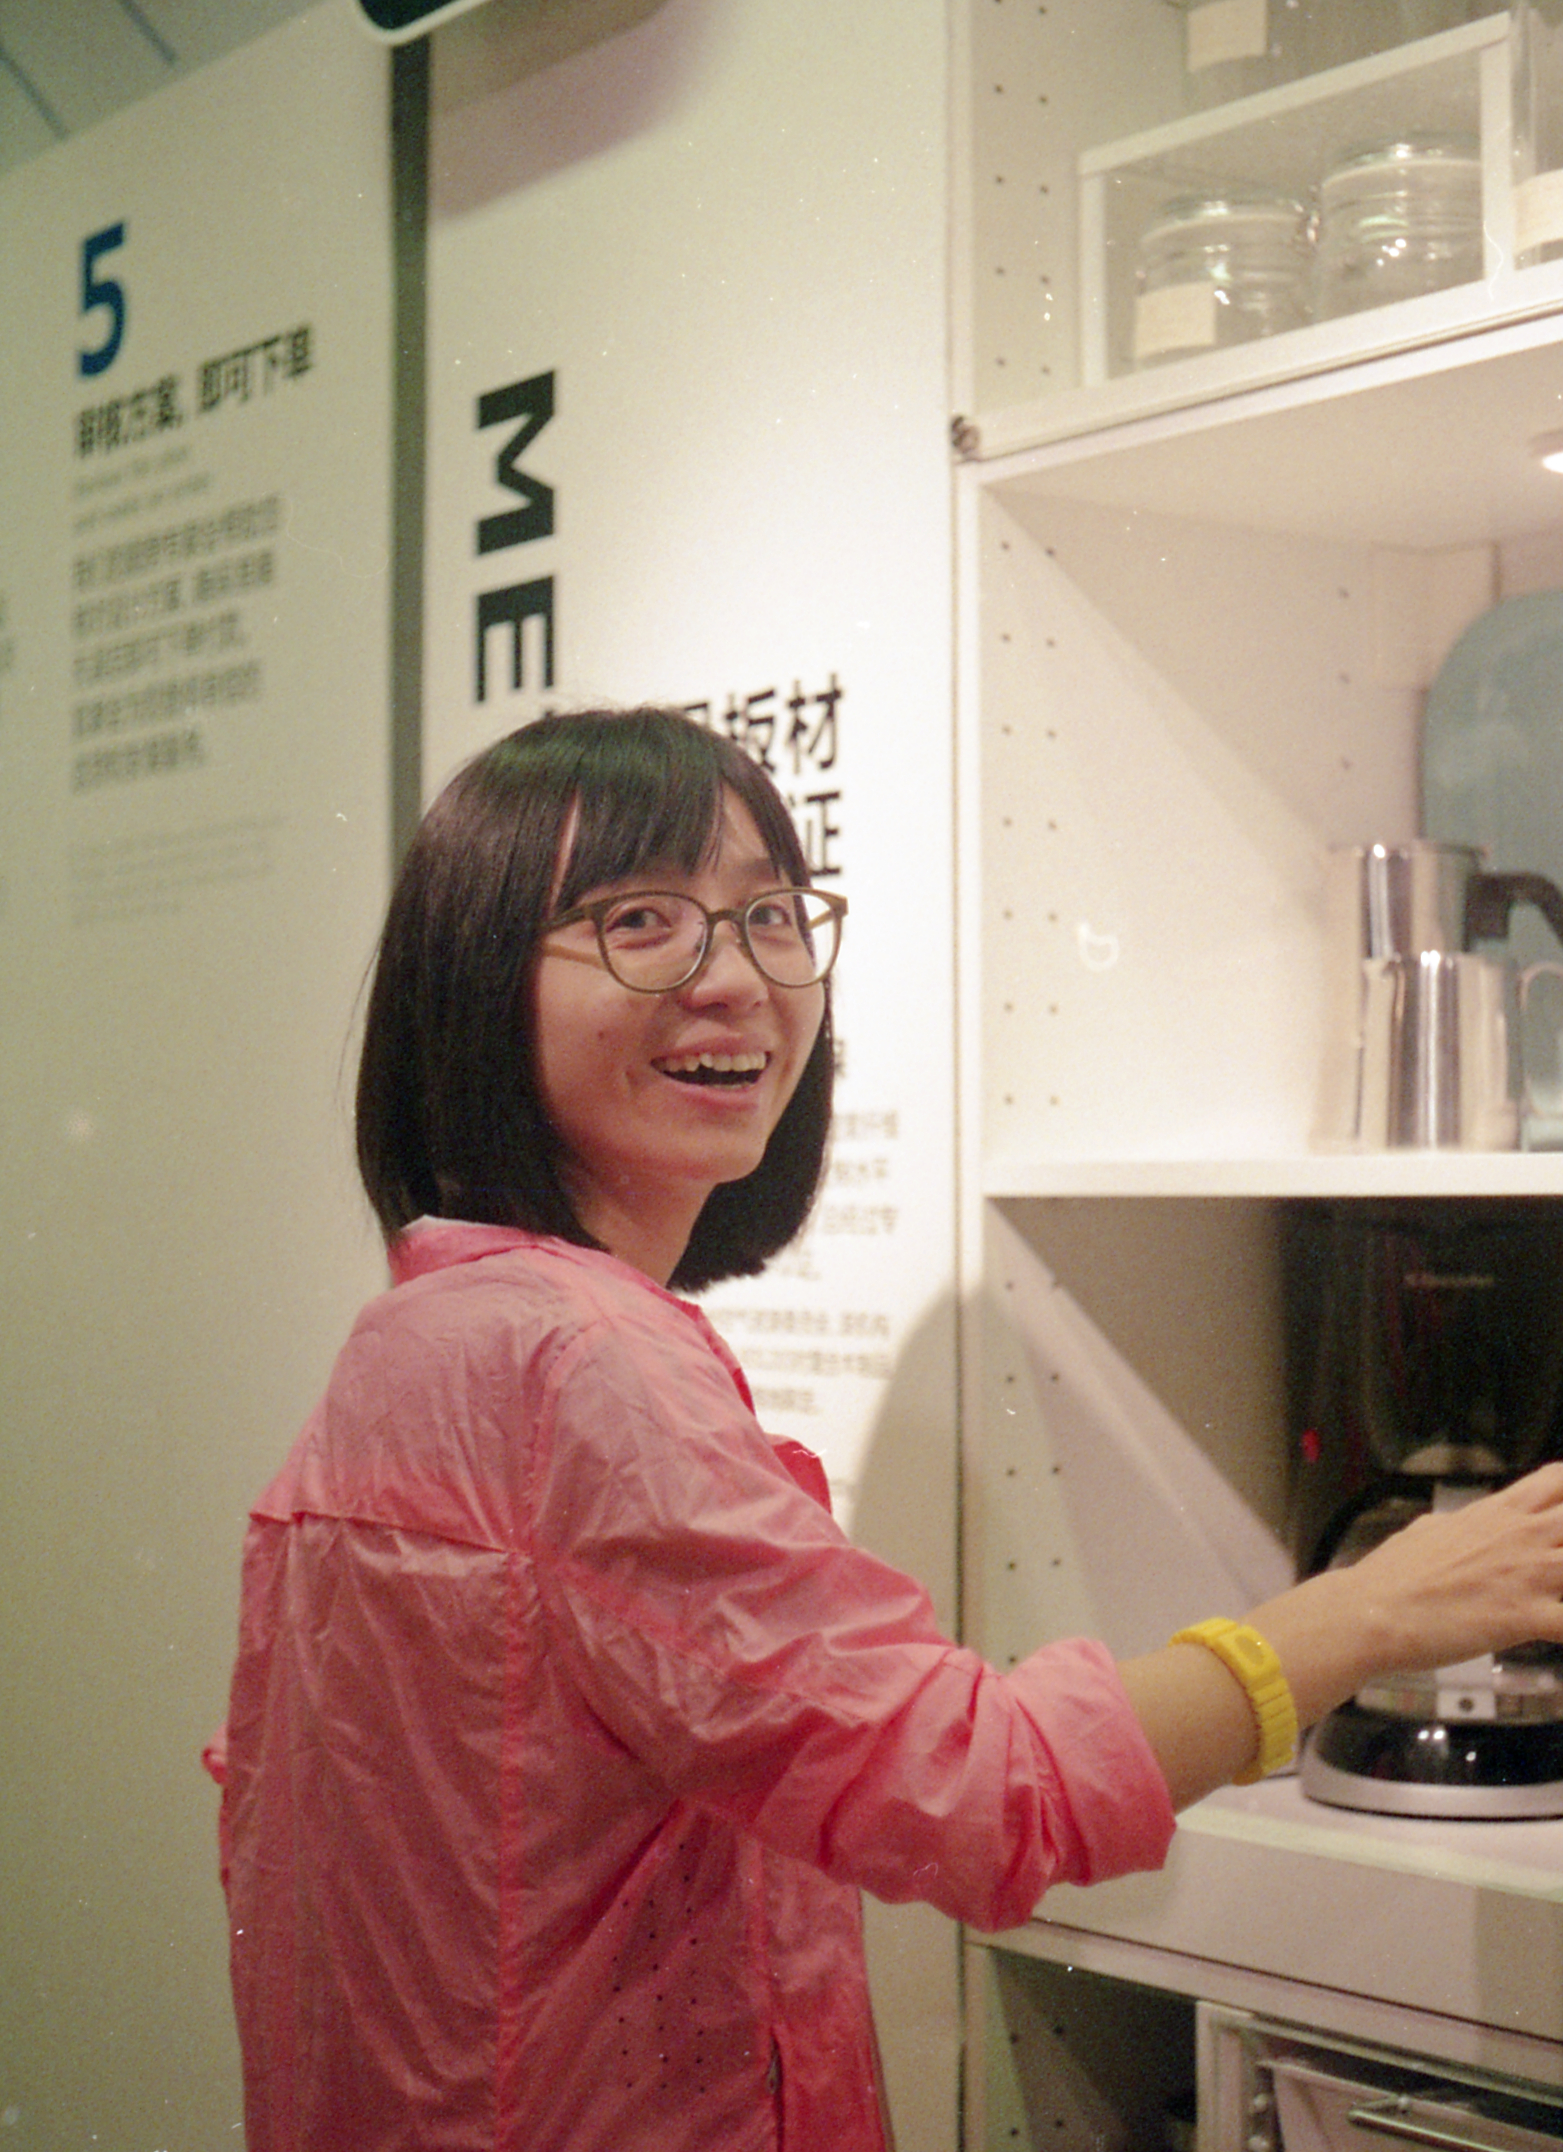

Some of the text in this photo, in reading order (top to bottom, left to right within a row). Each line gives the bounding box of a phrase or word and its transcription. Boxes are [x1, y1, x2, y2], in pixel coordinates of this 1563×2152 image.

[79, 222, 126, 377] 5
[475, 368, 556, 716] ME
[684, 673, 842, 774] 板材
